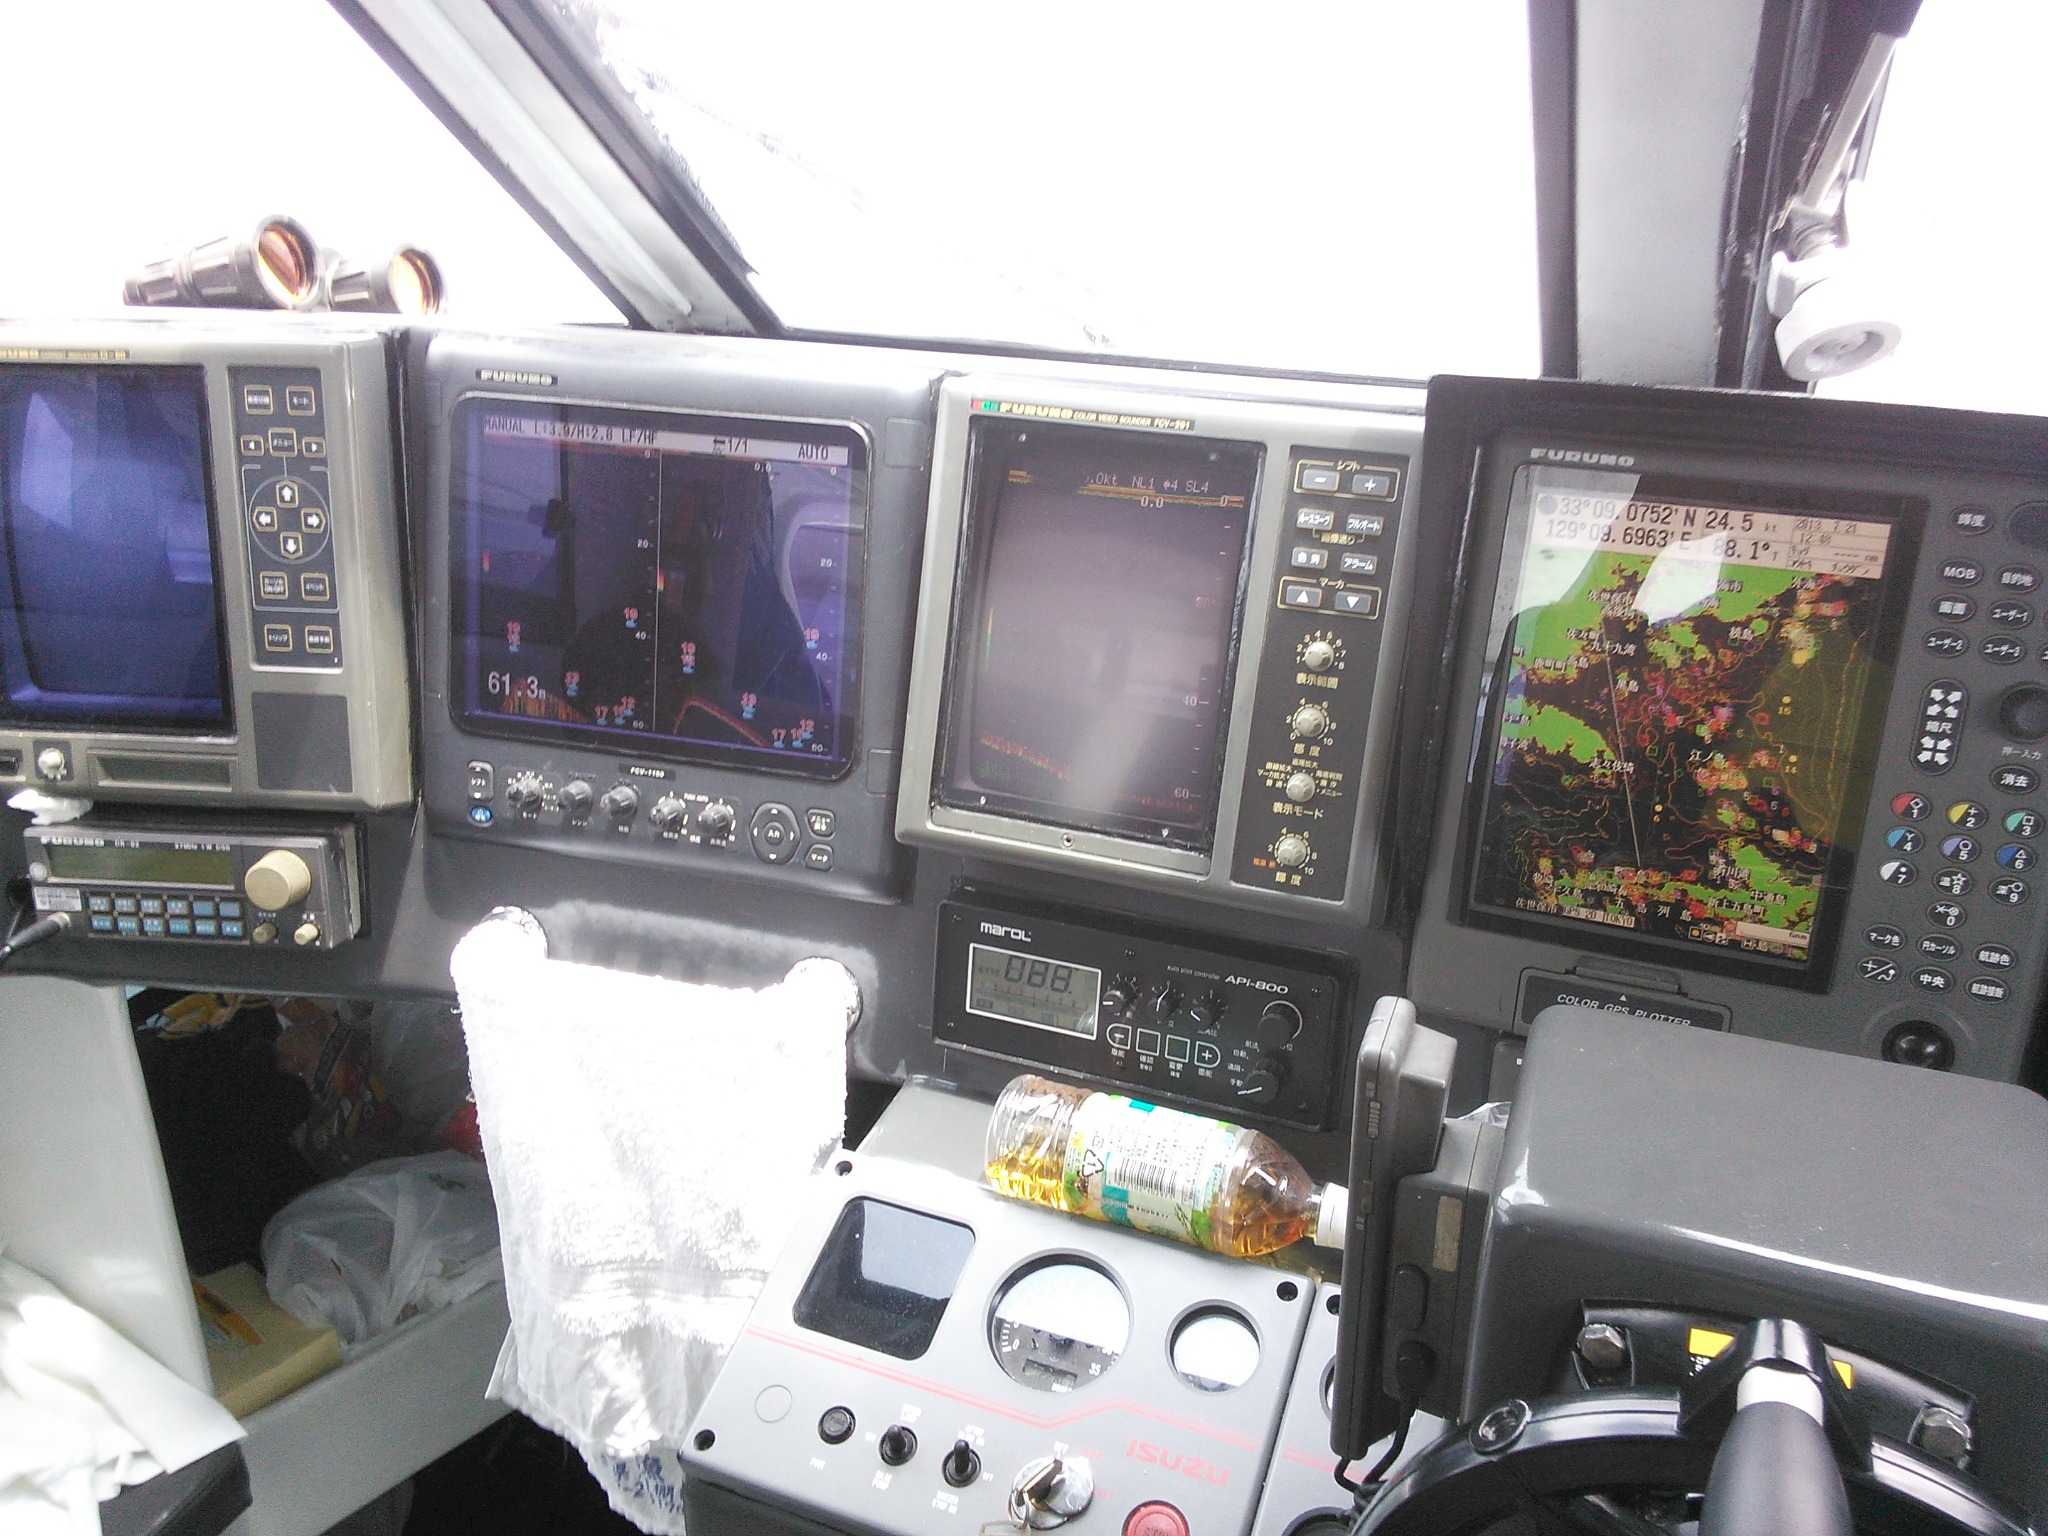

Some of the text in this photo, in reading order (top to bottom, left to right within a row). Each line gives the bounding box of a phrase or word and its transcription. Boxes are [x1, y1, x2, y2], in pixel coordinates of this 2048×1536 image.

[480, 370, 554, 386] FURUNO
[1001, 402, 1073, 420] FURUNO
[484, 416, 524, 433] MANUAL
[727, 437, 749, 453] 1/1
[798, 444, 829, 461] AUTO
[1530, 448, 1635, 467] FURUNO
[1132, 476, 1155, 489] NL1
[1185, 480, 1209, 494] SL4
[1140, 496, 1164, 508] 0.0
[1683, 508, 1697, 527] N
[1705, 511, 1754, 532] 24.5
[1943, 565, 1977, 580] MOB
[1286, 715, 1292, 724] 2
[1323, 737, 1334, 746] 10
[2000, 772, 2030, 788] 消去
[1174, 787, 1190, 799] 60
[1272, 801, 1324, 820] 表示モード
[1911, 809, 1919, 819] 1
[1966, 816, 1975, 828] 2
[2022, 825, 2031, 837] 3
[1903, 841, 1912, 852] 4
[1959, 849, 1968, 861] 5
[1304, 866, 1315, 876] 10
[2015, 858, 2024, 870] 6
[1897, 873, 1907, 885] 7
[1951, 883, 1961, 895] 8
[2009, 892, 2019, 904] 9
[1603, 914, 1633, 927] TOKYO
[1946, 915, 1955, 927] 0
[1869, 931, 1901, 948] マーク色
[1978, 950, 2011, 966] 航跡色
[1919, 972, 1946, 989] 中央
[1557, 993, 1600, 1010] COLOR
[1012, 1338, 1021, 1351] 0
[1088, 1361, 1102, 1377] 35
[1126, 1439, 1231, 1487] ISUZU
